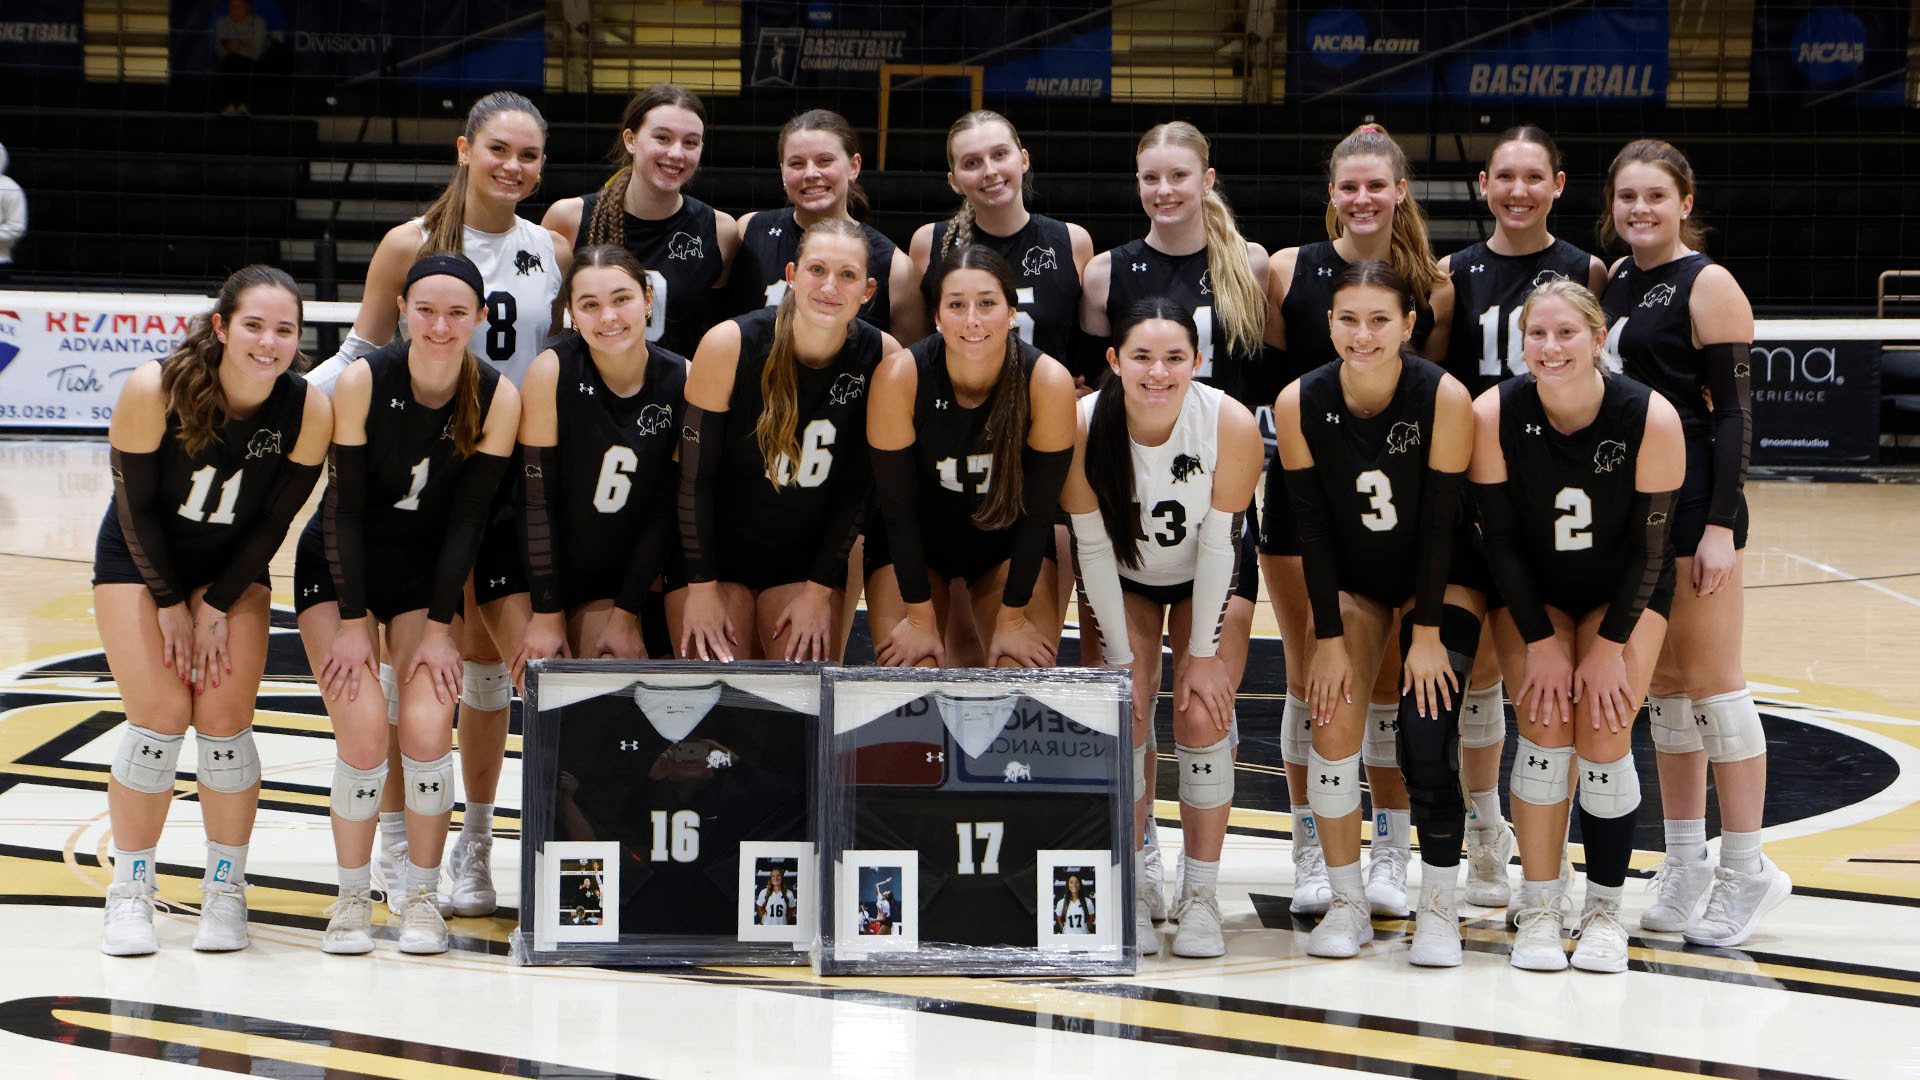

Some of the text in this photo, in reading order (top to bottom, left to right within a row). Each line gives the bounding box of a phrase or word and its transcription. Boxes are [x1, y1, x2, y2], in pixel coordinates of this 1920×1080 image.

[296, 31, 376, 53] Division
[803, 38, 905, 57] BASKETBALL
[1312, 34, 1420, 52] NCAA.com
[1797, 41, 1865, 63] NCAA
[1025, 77, 1103, 96] #NCAAD2
[1469, 63, 1655, 97] BASKETBALL
[46, 312, 188, 335] RE/MAX
[393, 457, 430, 511] 1
[593, 445, 638, 513] 6
[177, 464, 243, 525] 11
[1356, 470, 1398, 531] 3
[1554, 487, 1593, 551] 2
[650, 810, 700, 862] 16
[956, 822, 1004, 875] 17
[770, 904, 784, 918] 16
[1068, 914, 1082, 928] 17
